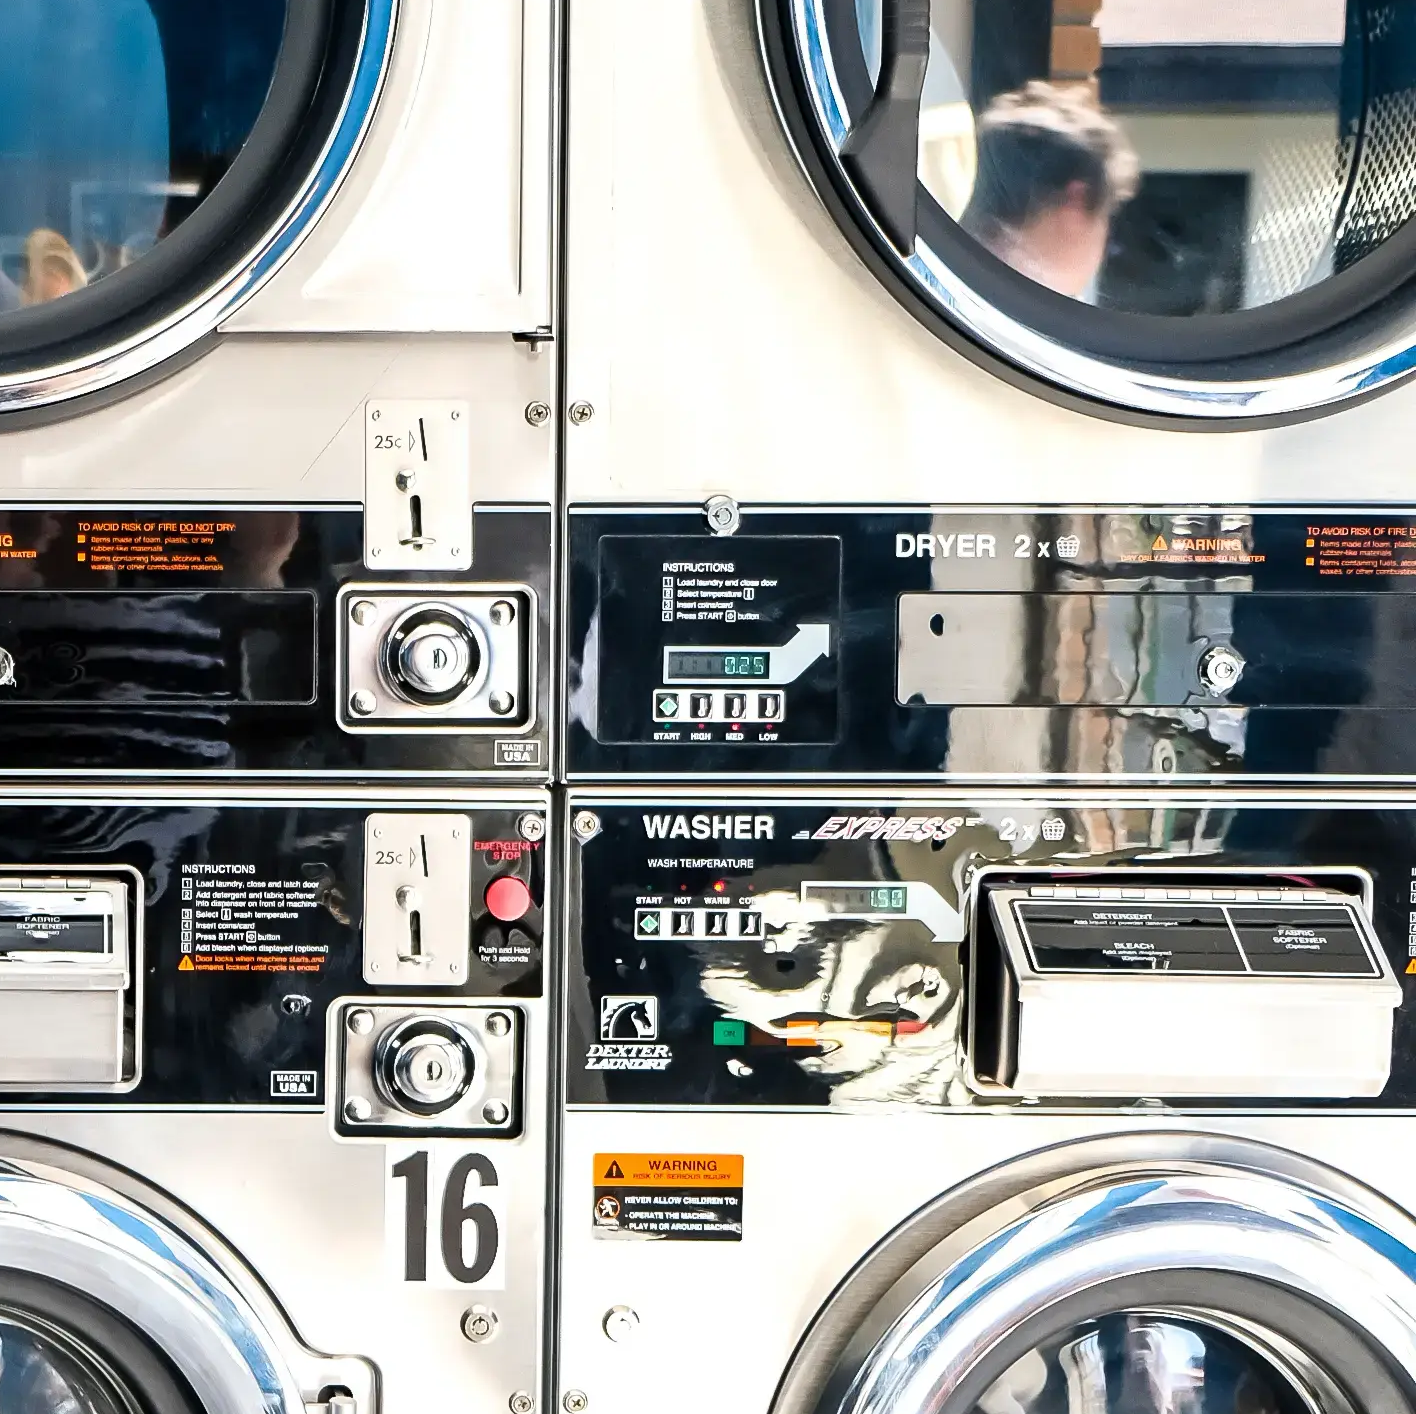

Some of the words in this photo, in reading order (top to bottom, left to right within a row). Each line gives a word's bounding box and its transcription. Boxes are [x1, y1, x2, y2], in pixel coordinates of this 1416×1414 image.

[78, 523, 90, 531] TO
[93, 523, 119, 531] AVOID
[121, 523, 141, 531] RISK
[144, 523, 154, 531] OF
[159, 523, 176, 531] FIRE
[180, 523, 193, 531] DO
[196, 523, 213, 531] NOT
[896, 535, 996, 558] DRYER
[1014, 536, 1030, 557] 2
[1172, 538, 1242, 551] WARNING
[663, 563, 734, 572] INSTRUCTIONS
[504, 752, 531, 761] USA
[643, 815, 773, 839] WASHER
[812, 817, 963, 840] EXPRESS
[1001, 819, 1016, 841] 2
[493, 852, 520, 860] STOP
[648, 859, 677, 868] WASH
[680, 859, 753, 868] TEMPERATURE
[182, 865, 255, 874] INSTRUCTIONS
[636, 897, 662, 905] START
[674, 897, 691, 905] HOT
[705, 897, 730, 905] WARM
[586, 1045, 669, 1057] DEXTER
[585, 1058, 671, 1070] LAUNDRY
[280, 1082, 307, 1093] USA
[649, 1160, 717, 1171] WARNING
[392, 1151, 499, 1283] 16
